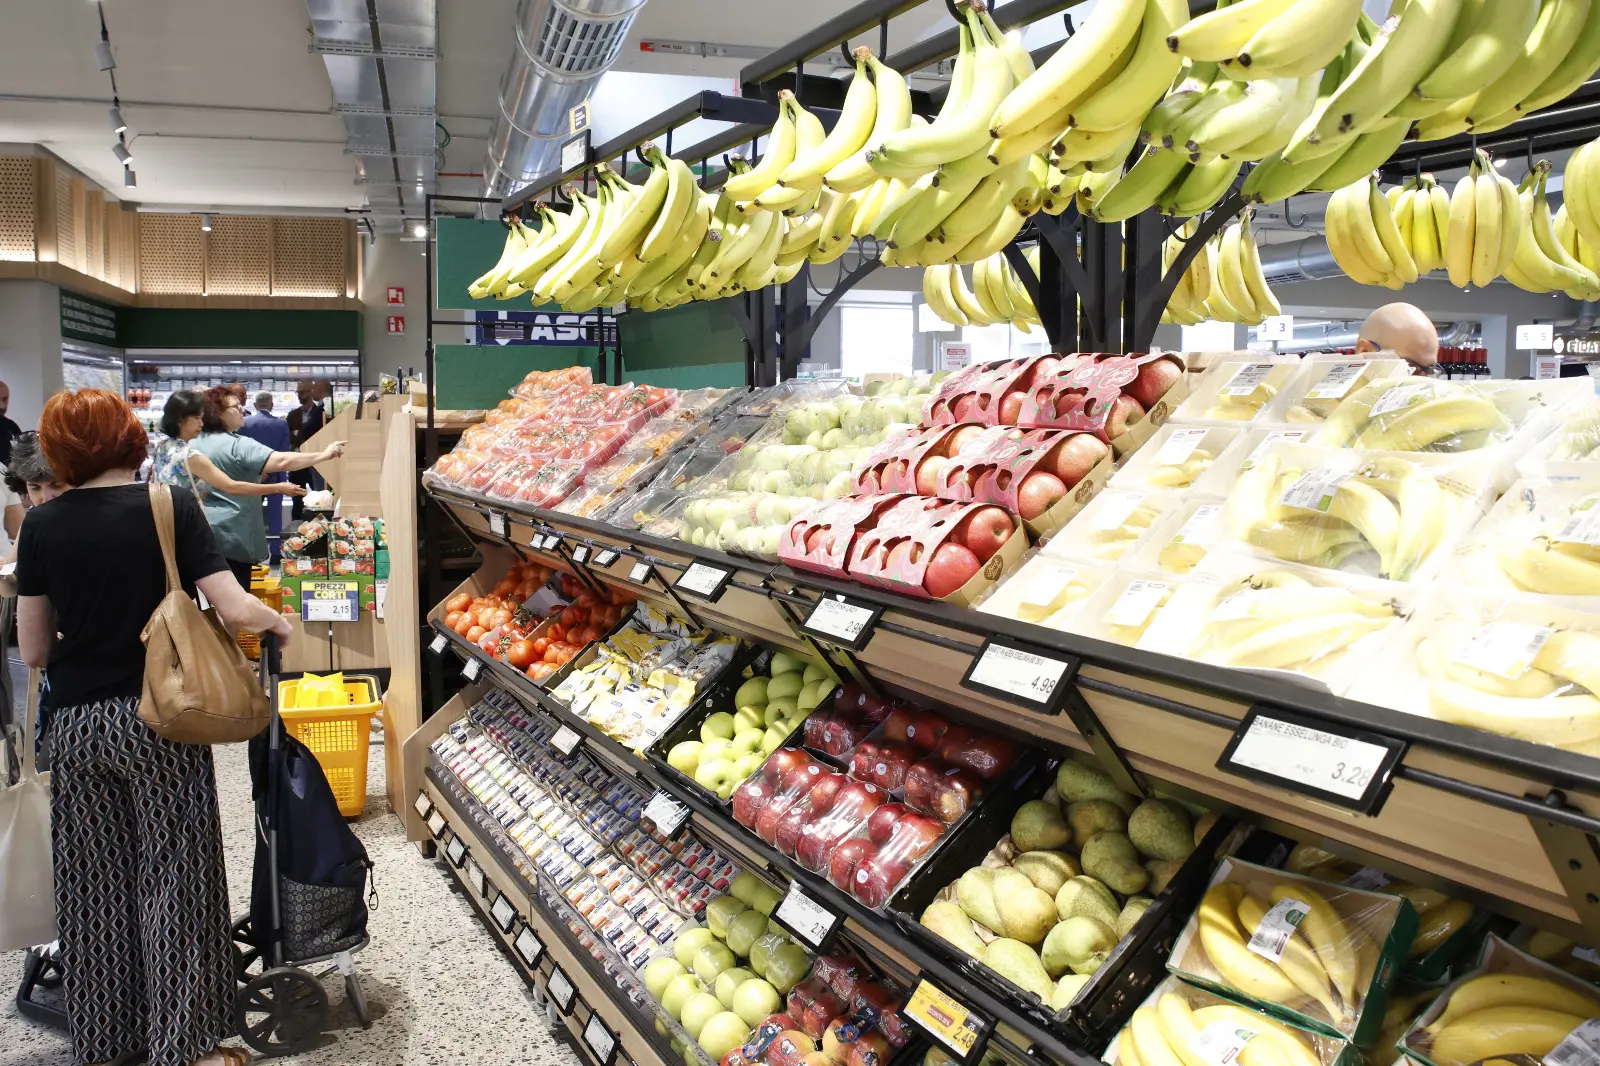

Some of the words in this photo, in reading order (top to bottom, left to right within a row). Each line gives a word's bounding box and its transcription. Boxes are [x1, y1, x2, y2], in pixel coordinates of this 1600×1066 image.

[1279, 322, 1286, 332] 3
[314, 590, 346, 600] CORTI
[845, 620, 863, 634] 2.98
[1031, 676, 1056, 694] 4.98
[1252, 716, 1284, 734] BANANE
[1283, 724, 1332, 745] ESSELUNGA
[1332, 737, 1348, 749] BIO
[1331, 761, 1371, 788] 3.28
[811, 922, 828, 940] 2.78
[937, 991, 951, 1006] PERE
[951, 1001, 969, 1017] ABATE
[952, 1024, 975, 1049] 2.48
